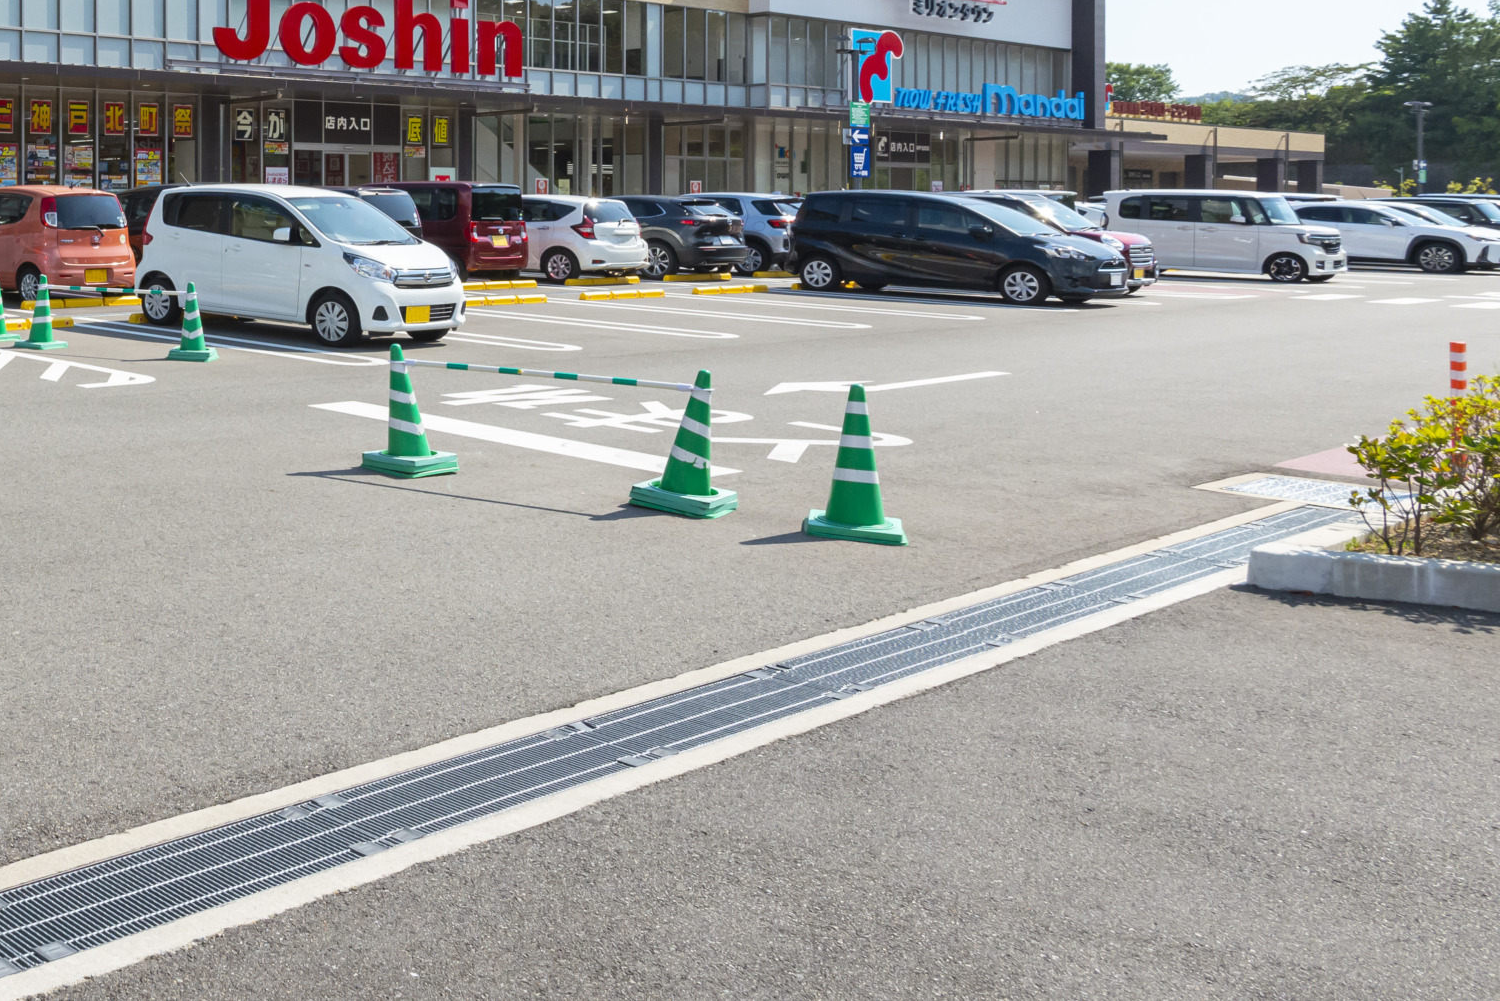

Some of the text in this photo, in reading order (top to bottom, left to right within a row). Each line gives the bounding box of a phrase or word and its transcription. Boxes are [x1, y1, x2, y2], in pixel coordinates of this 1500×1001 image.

[325, 115, 371, 131] 店内入口
[890, 142, 915, 153] 店内入口
